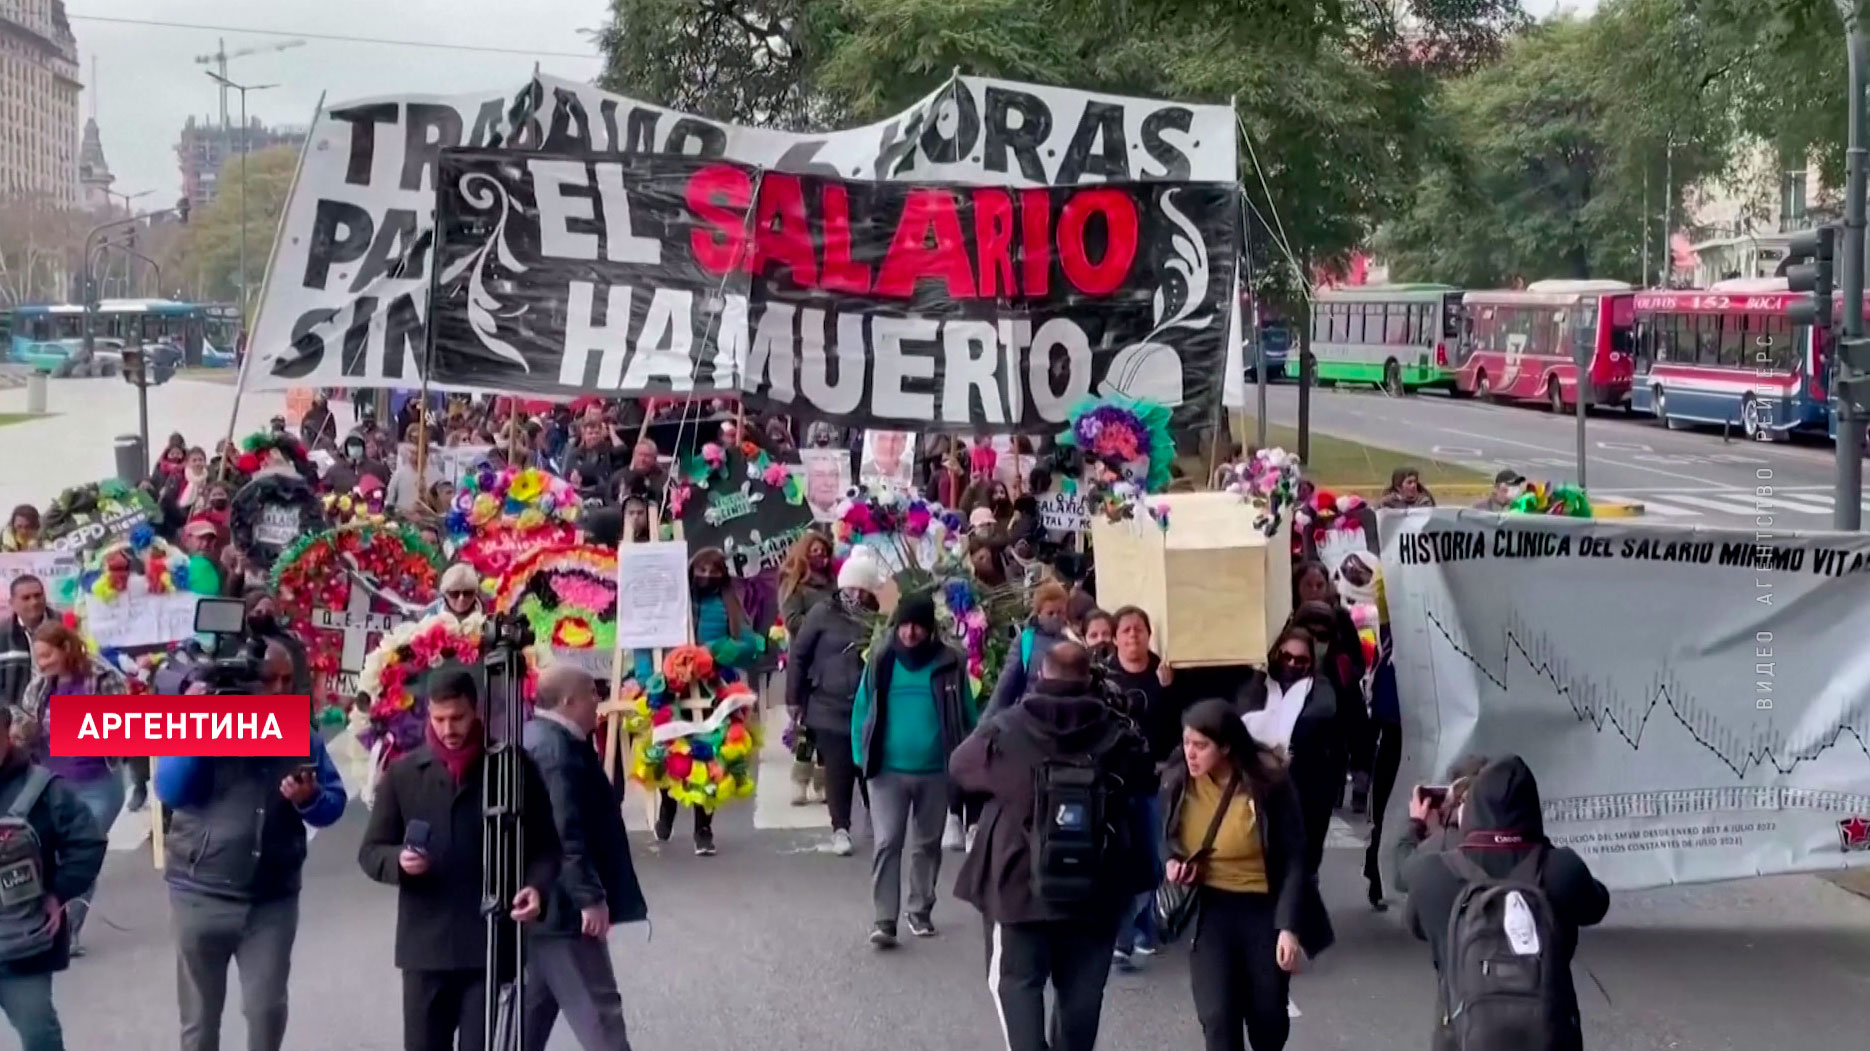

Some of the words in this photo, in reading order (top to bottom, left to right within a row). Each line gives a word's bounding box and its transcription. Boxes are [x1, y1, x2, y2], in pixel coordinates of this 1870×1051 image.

[527, 159, 662, 265] EL
[685, 164, 1138, 298] SALARIO
[1692, 296, 1731, 310] 152
[1746, 296, 1783, 310] BOCA
[270, 292, 427, 379] SIN
[560, 281, 695, 392] HA
[713, 293, 1094, 425] MUERTO
[1041, 500, 1086, 516] ALARIO
[1400, 531, 1485, 565] HISTORIA
[1493, 529, 1571, 559] CLINICA
[1578, 536, 1614, 558] DEL
[1621, 538, 1714, 564] SALARIO
[1718, 541, 1805, 572] MINIMO
[1494, 835, 1522, 844] Canon
[1552, 833, 1596, 845] VOLUCIÓN
